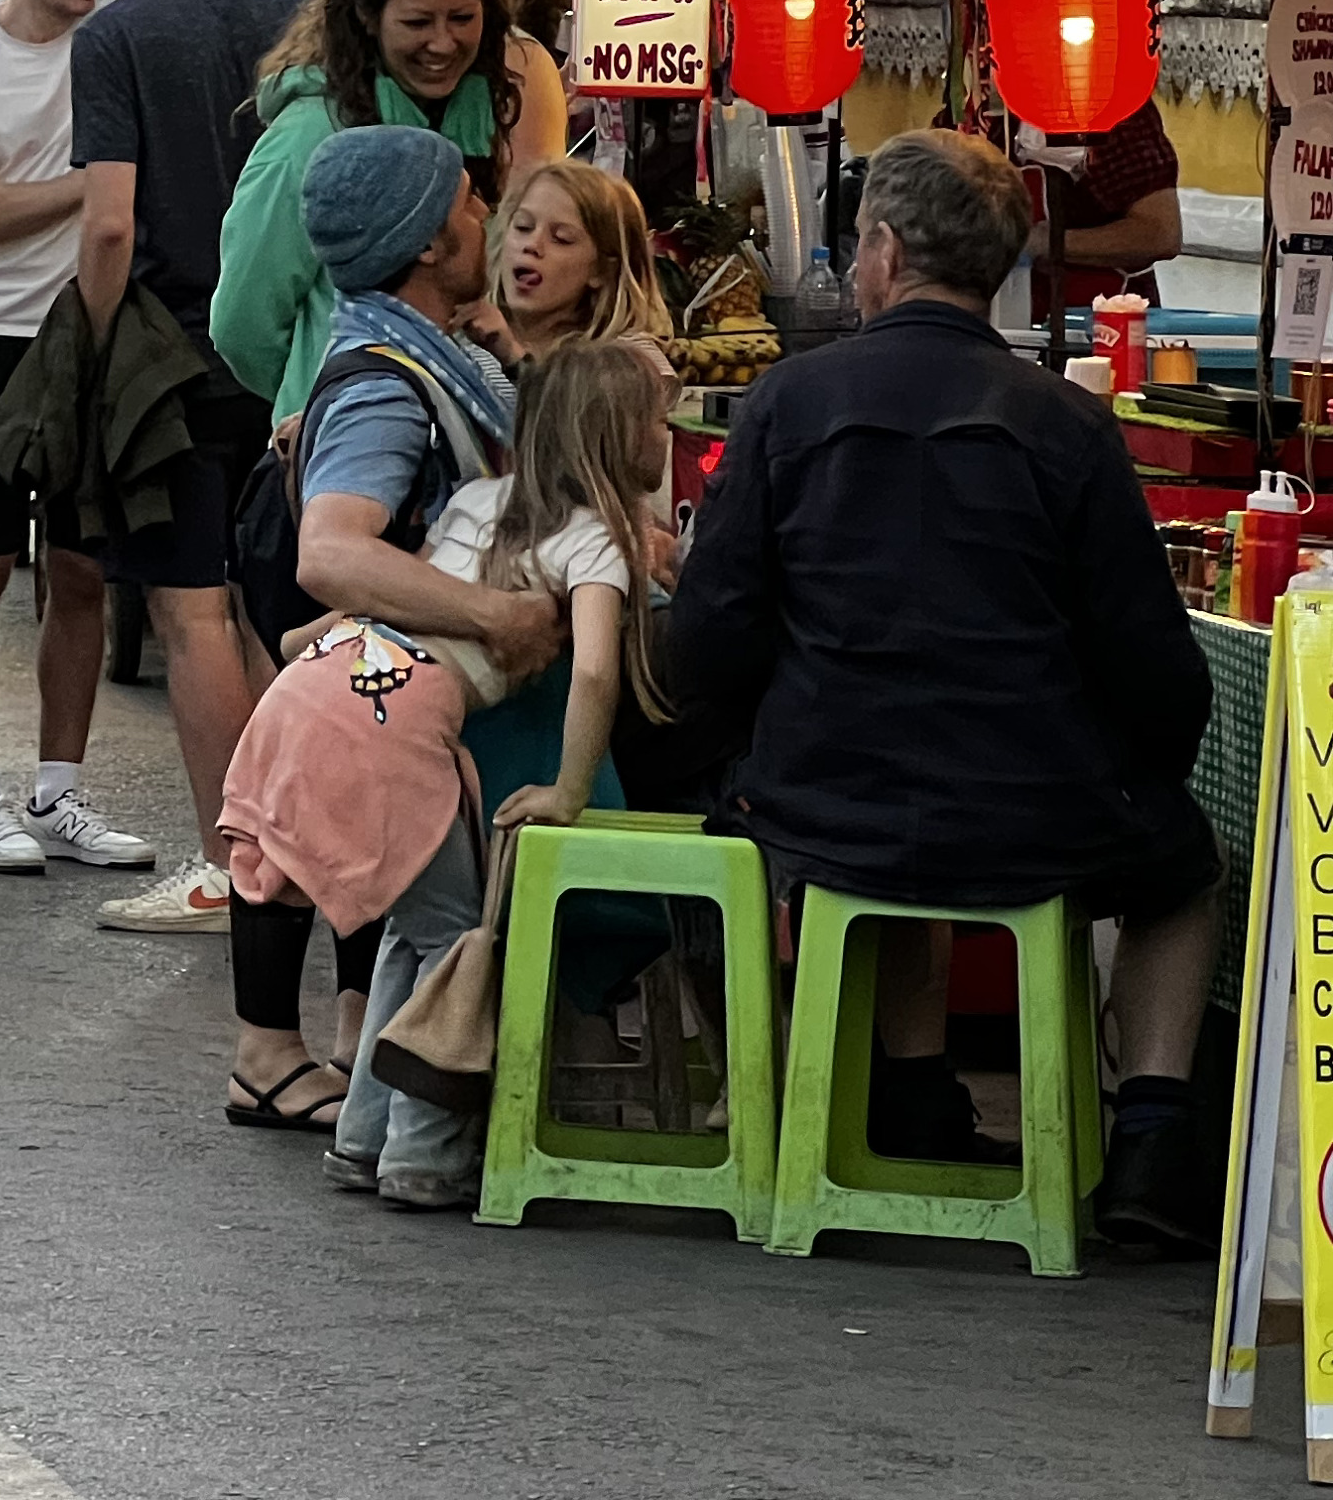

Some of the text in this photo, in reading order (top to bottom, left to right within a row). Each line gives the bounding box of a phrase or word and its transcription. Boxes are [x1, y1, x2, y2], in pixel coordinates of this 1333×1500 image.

[593, 42, 696, 84] NO MSG
[1310, 191, 1332, 220] 120
